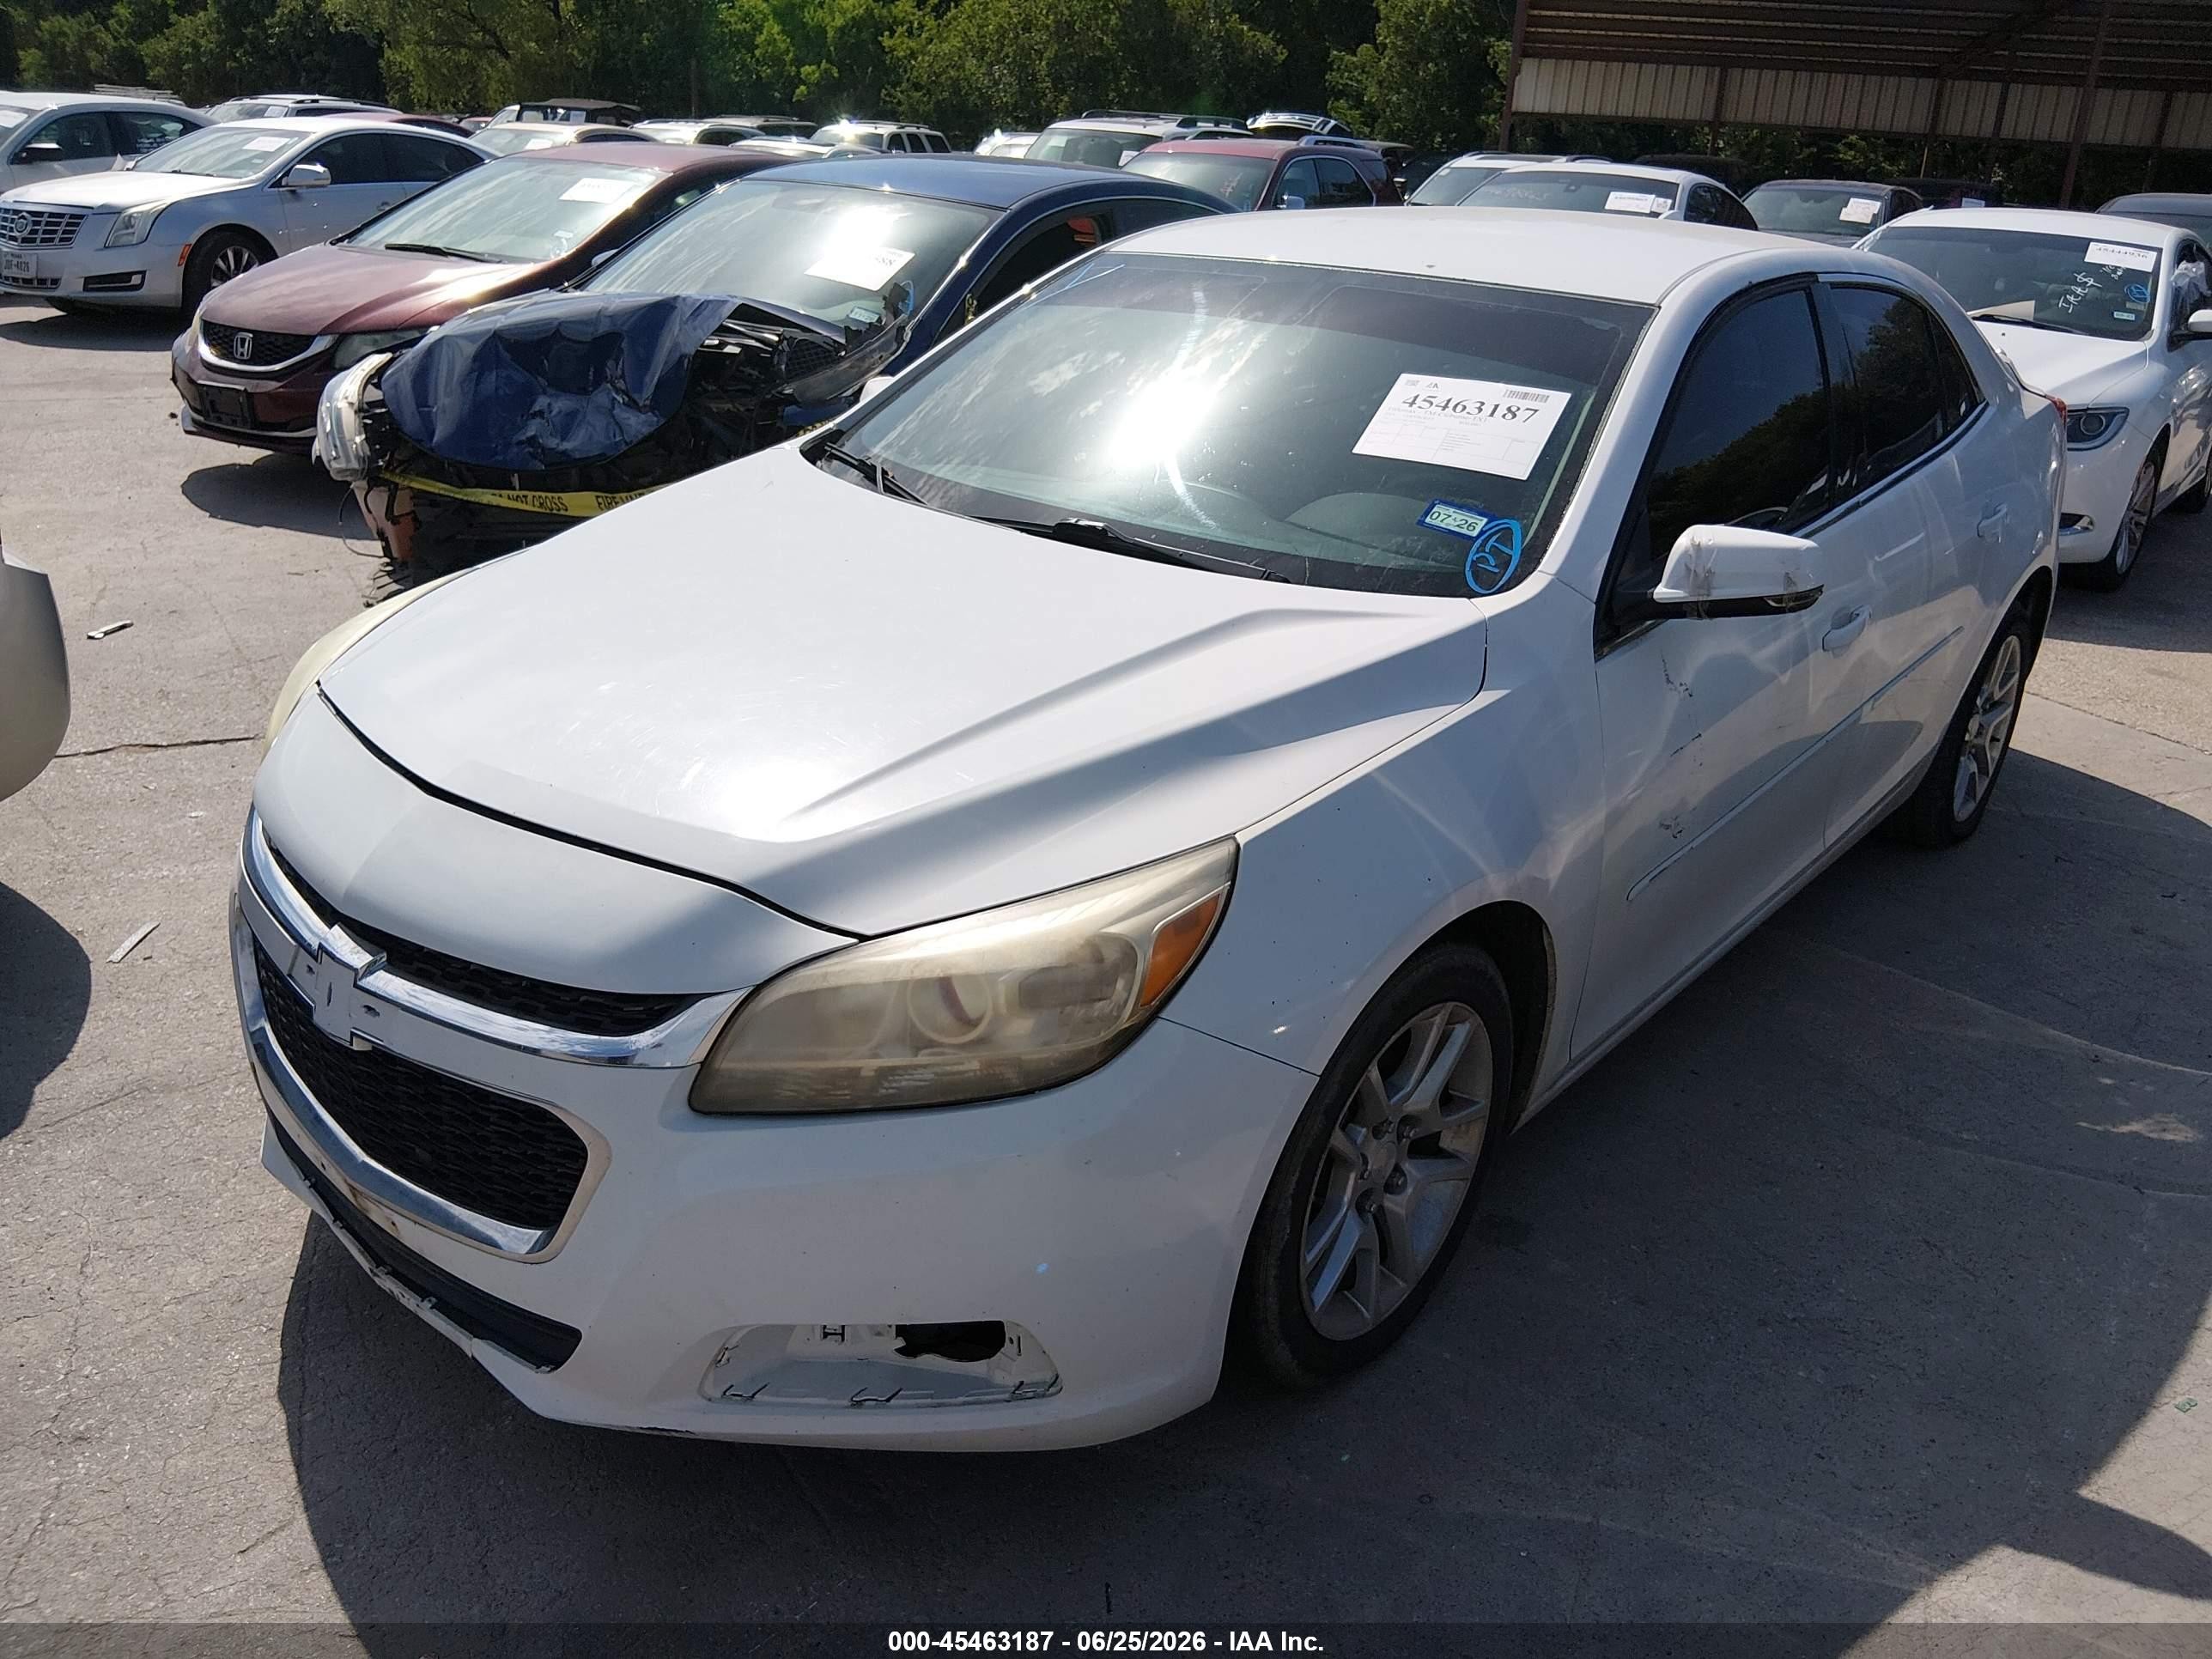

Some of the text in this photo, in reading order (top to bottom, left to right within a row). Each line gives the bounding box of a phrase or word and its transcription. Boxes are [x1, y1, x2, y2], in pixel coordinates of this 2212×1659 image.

[1402, 393, 1540, 423] 45463187
[532, 494, 568, 512] CROSS
[1429, 510, 1479, 532] 07 26
